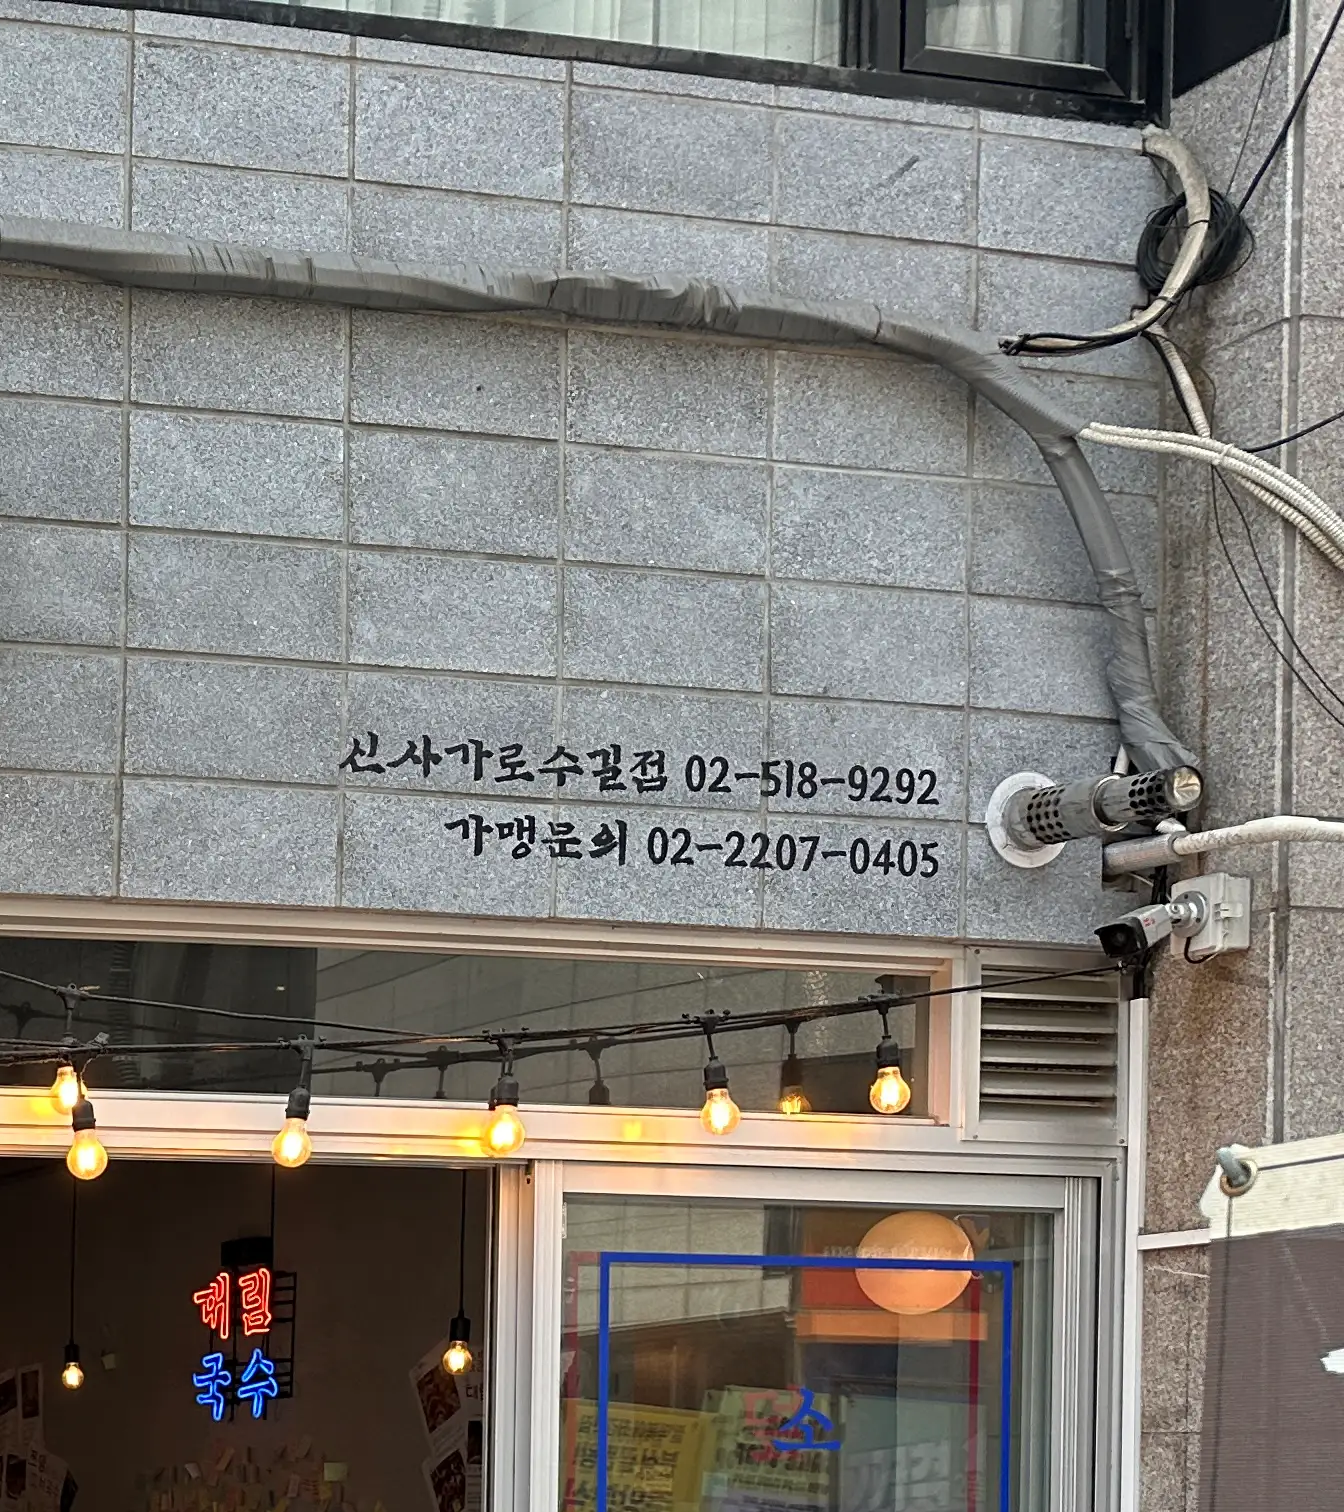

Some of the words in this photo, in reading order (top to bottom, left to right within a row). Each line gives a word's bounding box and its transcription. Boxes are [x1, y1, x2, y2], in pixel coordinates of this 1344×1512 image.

[338, 731, 669, 793] 신사가로수길점
[685, 754, 941, 806] 02-518-9292
[444, 813, 628, 867] 가맹문의
[647, 825, 941, 879] 02-2207-0405
[192, 1267, 273, 1340] 대림
[192, 1348, 280, 1422] 국수
